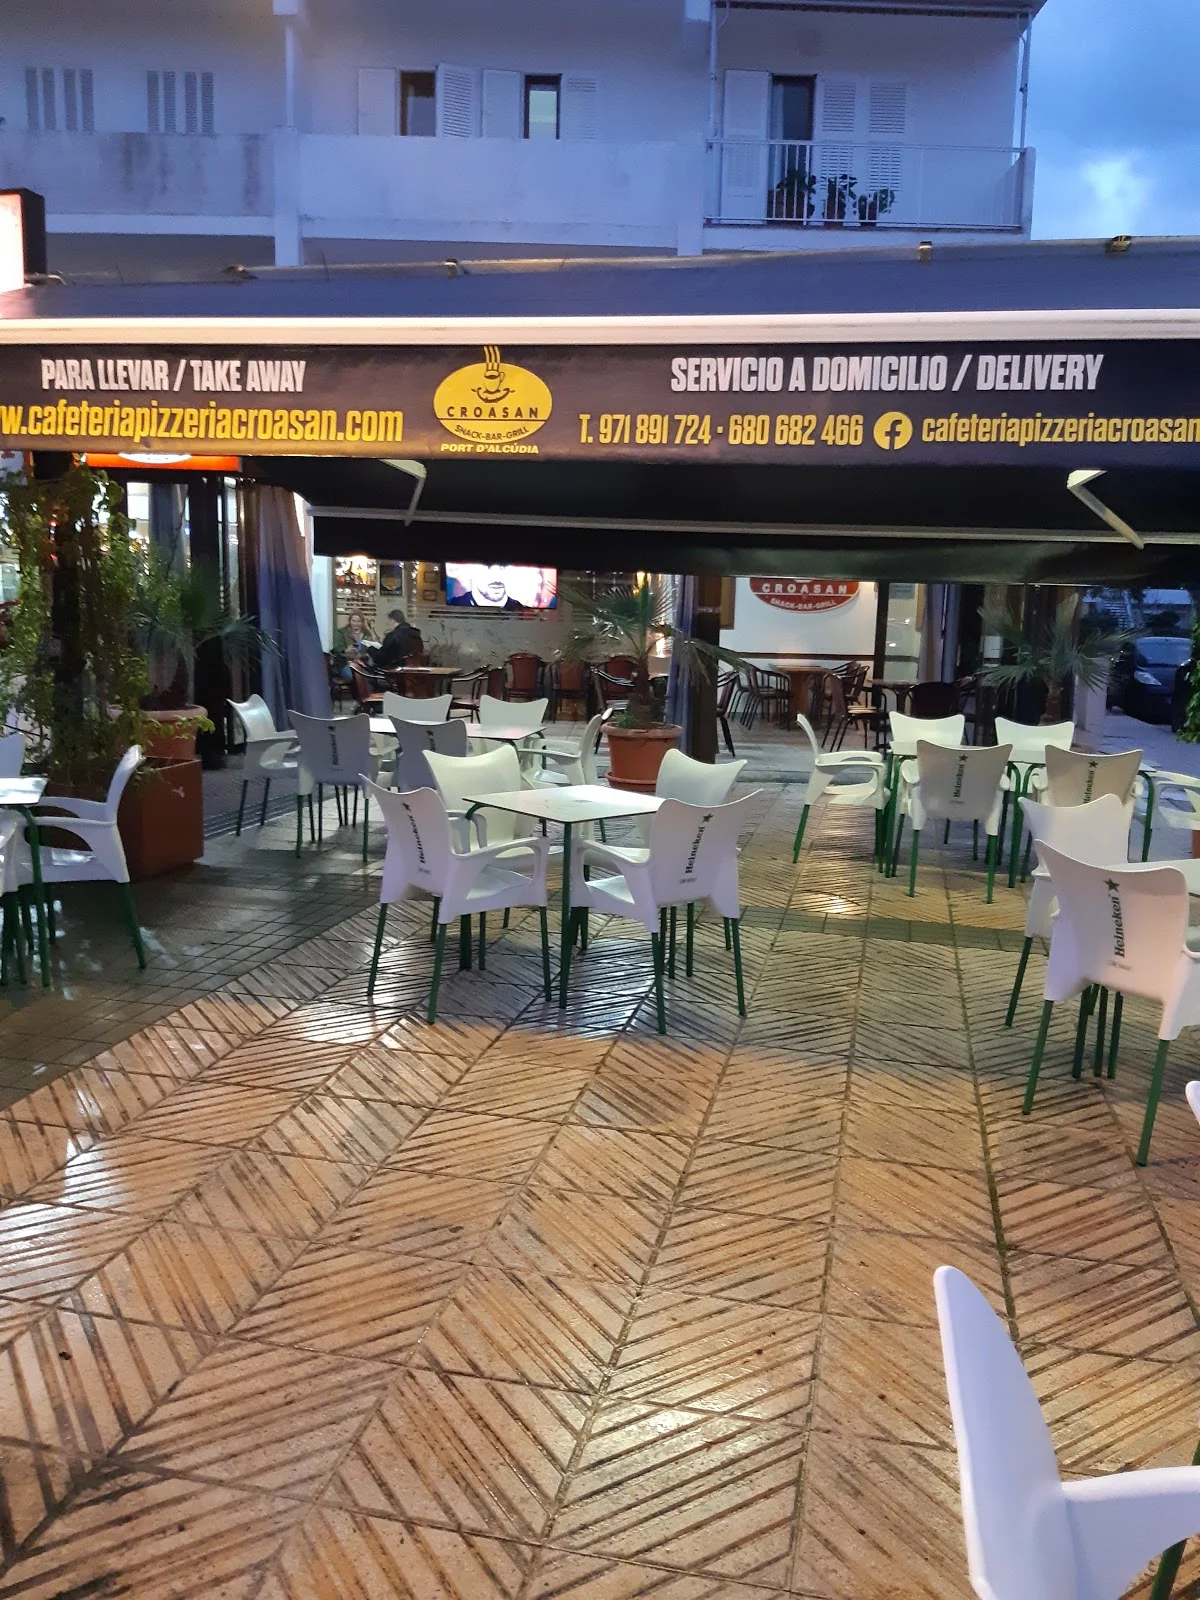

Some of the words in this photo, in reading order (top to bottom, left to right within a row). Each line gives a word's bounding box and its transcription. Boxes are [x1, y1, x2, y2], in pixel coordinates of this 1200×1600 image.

[41, 359, 95, 390] PARA
[98, 359, 169, 391] LLEVAR
[190, 360, 242, 391] TAKE
[246, 361, 306, 392] AWAY
[671, 356, 783, 392] SERVICIO
[788, 357, 806, 391] A
[812, 355, 948, 391] DOMICILIO
[976, 354, 1104, 391] DELIVERY
[447, 406, 539, 418] CROASAN
[455, 425, 529, 440] SNACK-BAR-GRILL
[579, 414, 593, 443] T.
[599, 414, 631, 444] 971
[635, 414, 669, 444] 891
[674, 414, 711, 445] 724
[728, 414, 770, 445] 680
[774, 414, 817, 445] 682
[821, 414, 864, 445] 466
[921, 412, 1200, 447] cafeteriapizzeriacroasan
[441, 444, 473, 452] PORT
[762, 583, 847, 594] CROASAN
[408, 814, 426, 864] Heineken
[685, 826, 705, 874] Heineken
[1111, 896, 1125, 958] Heineken
